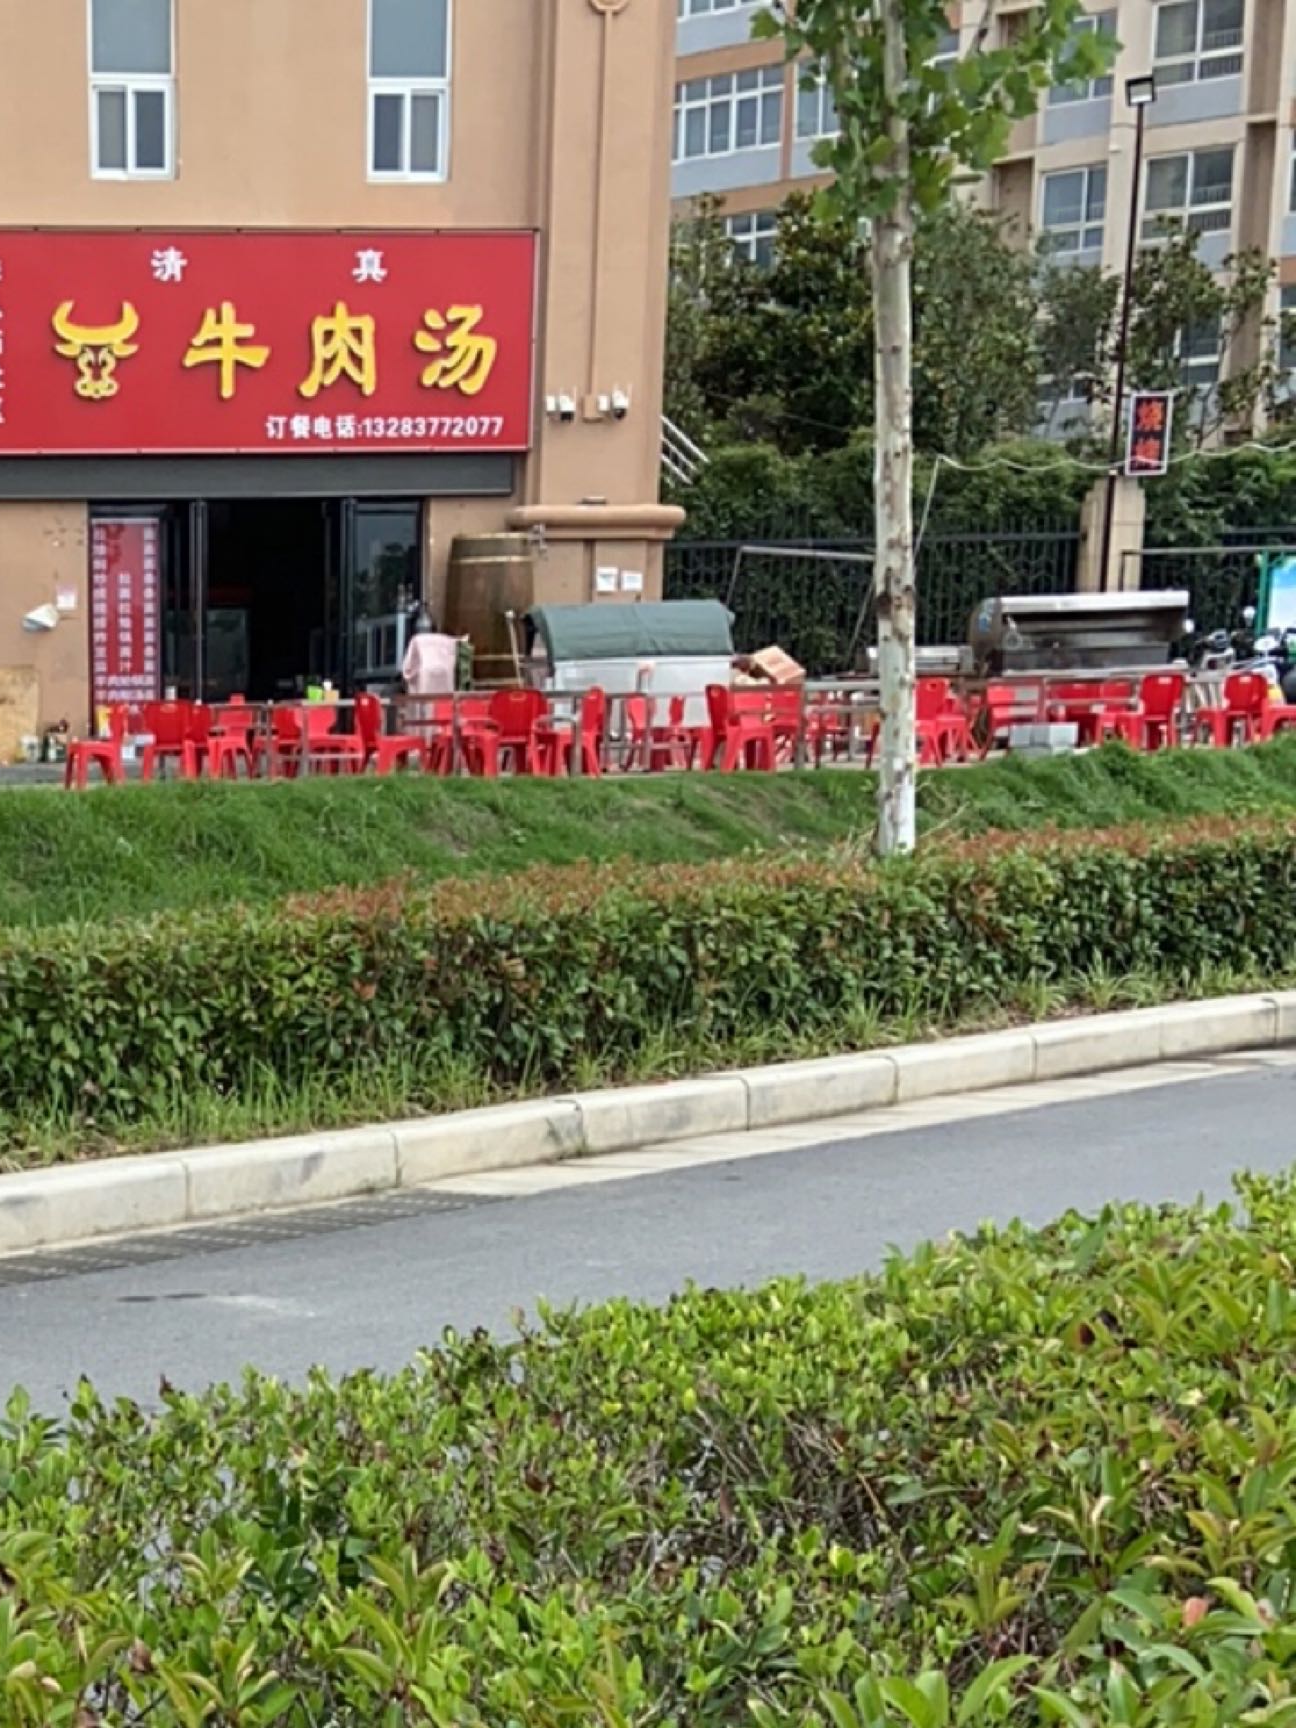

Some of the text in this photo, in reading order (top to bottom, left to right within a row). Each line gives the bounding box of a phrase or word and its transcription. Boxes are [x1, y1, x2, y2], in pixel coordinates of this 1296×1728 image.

[150, 246, 388, 283] 清真
[182, 301, 497, 399] 牛肉汤
